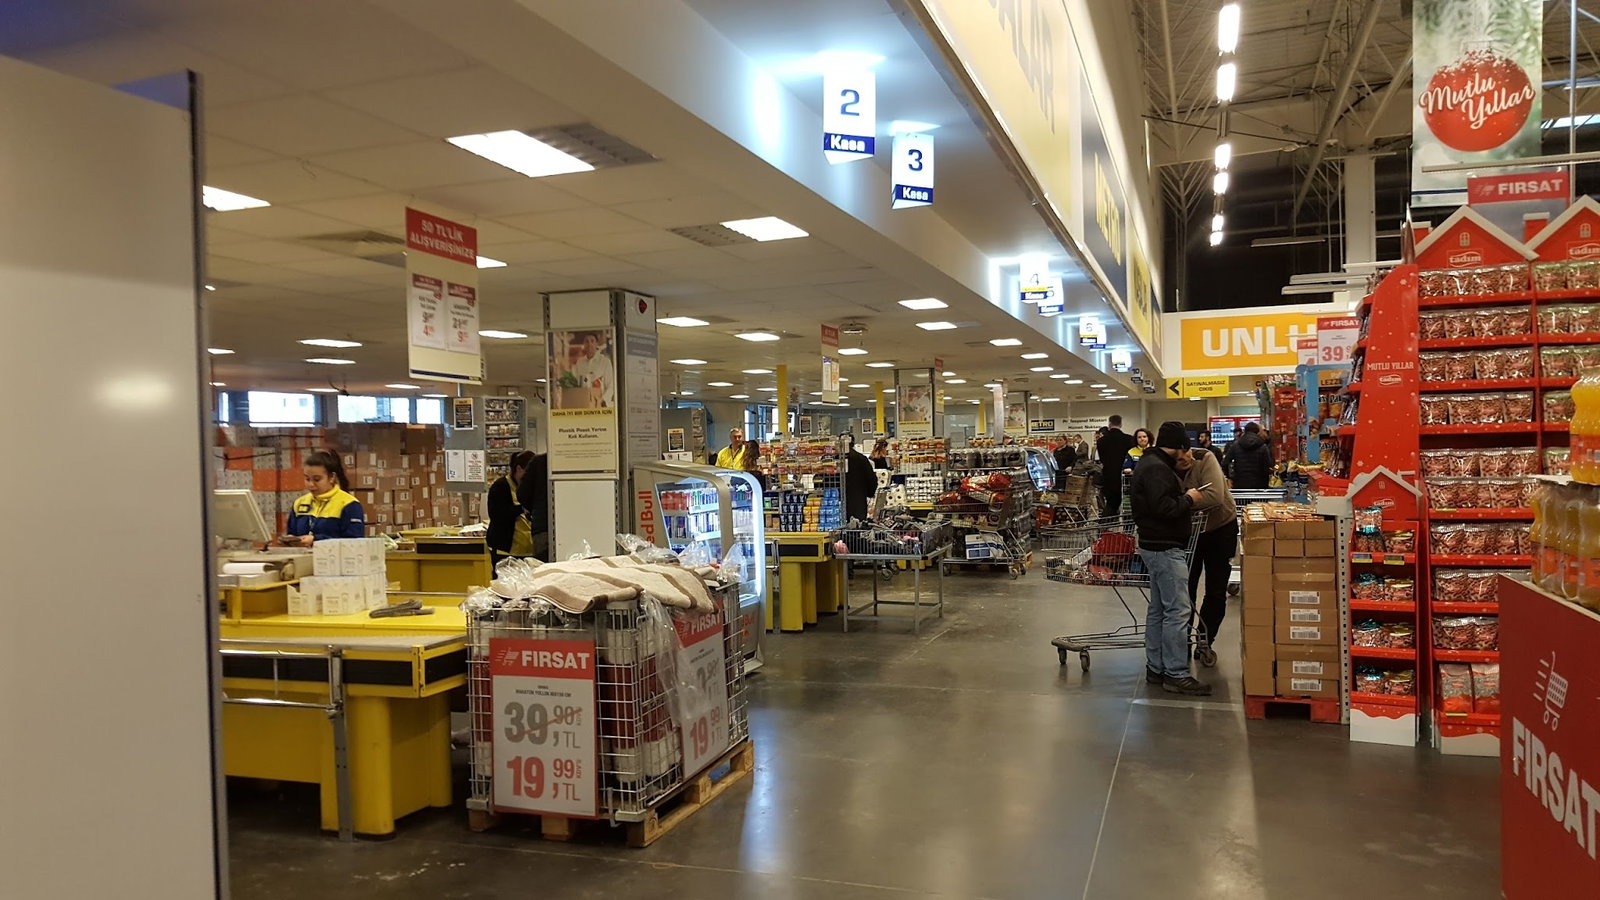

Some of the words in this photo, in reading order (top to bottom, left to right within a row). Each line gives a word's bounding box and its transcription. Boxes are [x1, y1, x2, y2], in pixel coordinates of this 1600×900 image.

[840, 88, 860, 117] 2
[1419, 72, 1495, 114] Mutlu
[1461, 84, 1536, 130] Yıllar
[830, 135, 865, 152] Kasa
[908, 148, 923, 172] 3
[902, 187, 929, 201] Kasa
[1498, 179, 1563, 195] FIRSAT
[421, 219, 434, 234] 50
[1322, 346, 1343, 361] 39
[1392, 361, 1414, 369] YILLAR
[638, 491, 654, 521] Bull
[521, 650, 590, 670] FIRSAT
[504, 701, 548, 745] 39
[553, 704, 575, 726] 90
[690, 715, 708, 761] 19
[506, 755, 545, 799] 19
[553, 758, 575, 779] 99
[1512, 716, 1600, 862] FIRSAT
